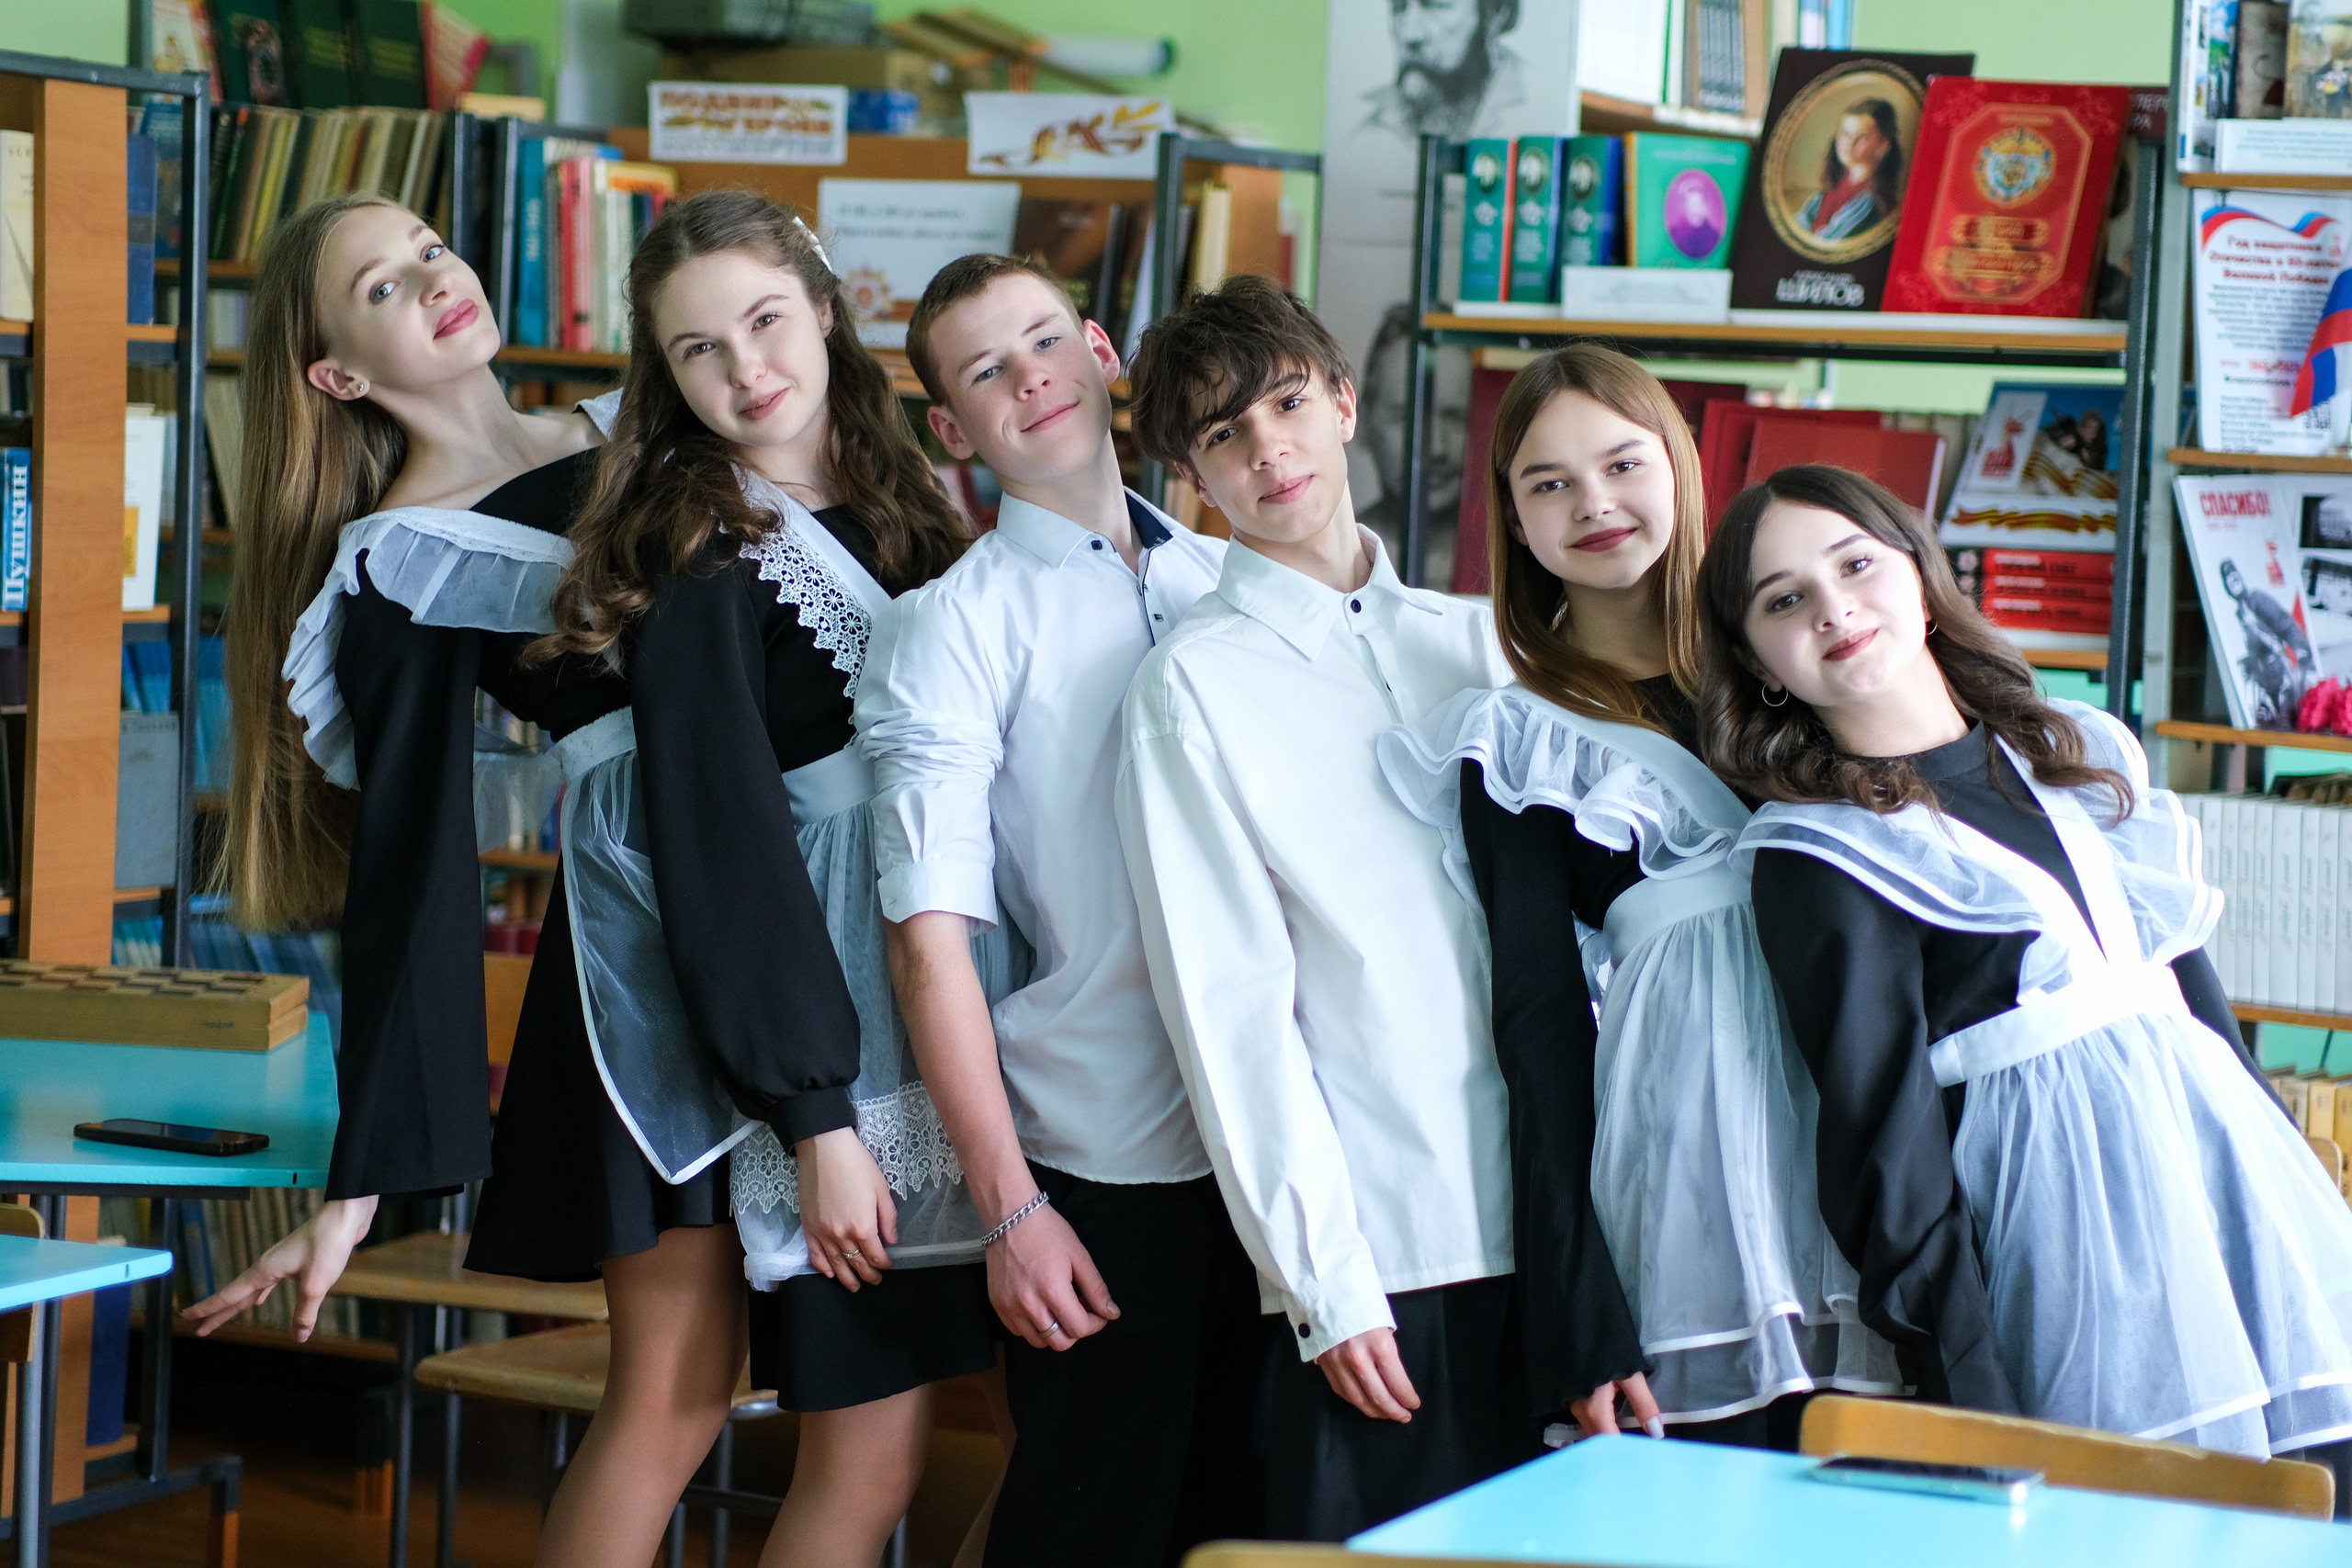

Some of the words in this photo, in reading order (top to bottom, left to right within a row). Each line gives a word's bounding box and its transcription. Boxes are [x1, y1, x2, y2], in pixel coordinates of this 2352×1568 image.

[1775, 277, 1866, 308] ШИЛОВ
[2199, 491, 2272, 516] СПАСИБО!
[6, 466, 28, 602] Пушкин
